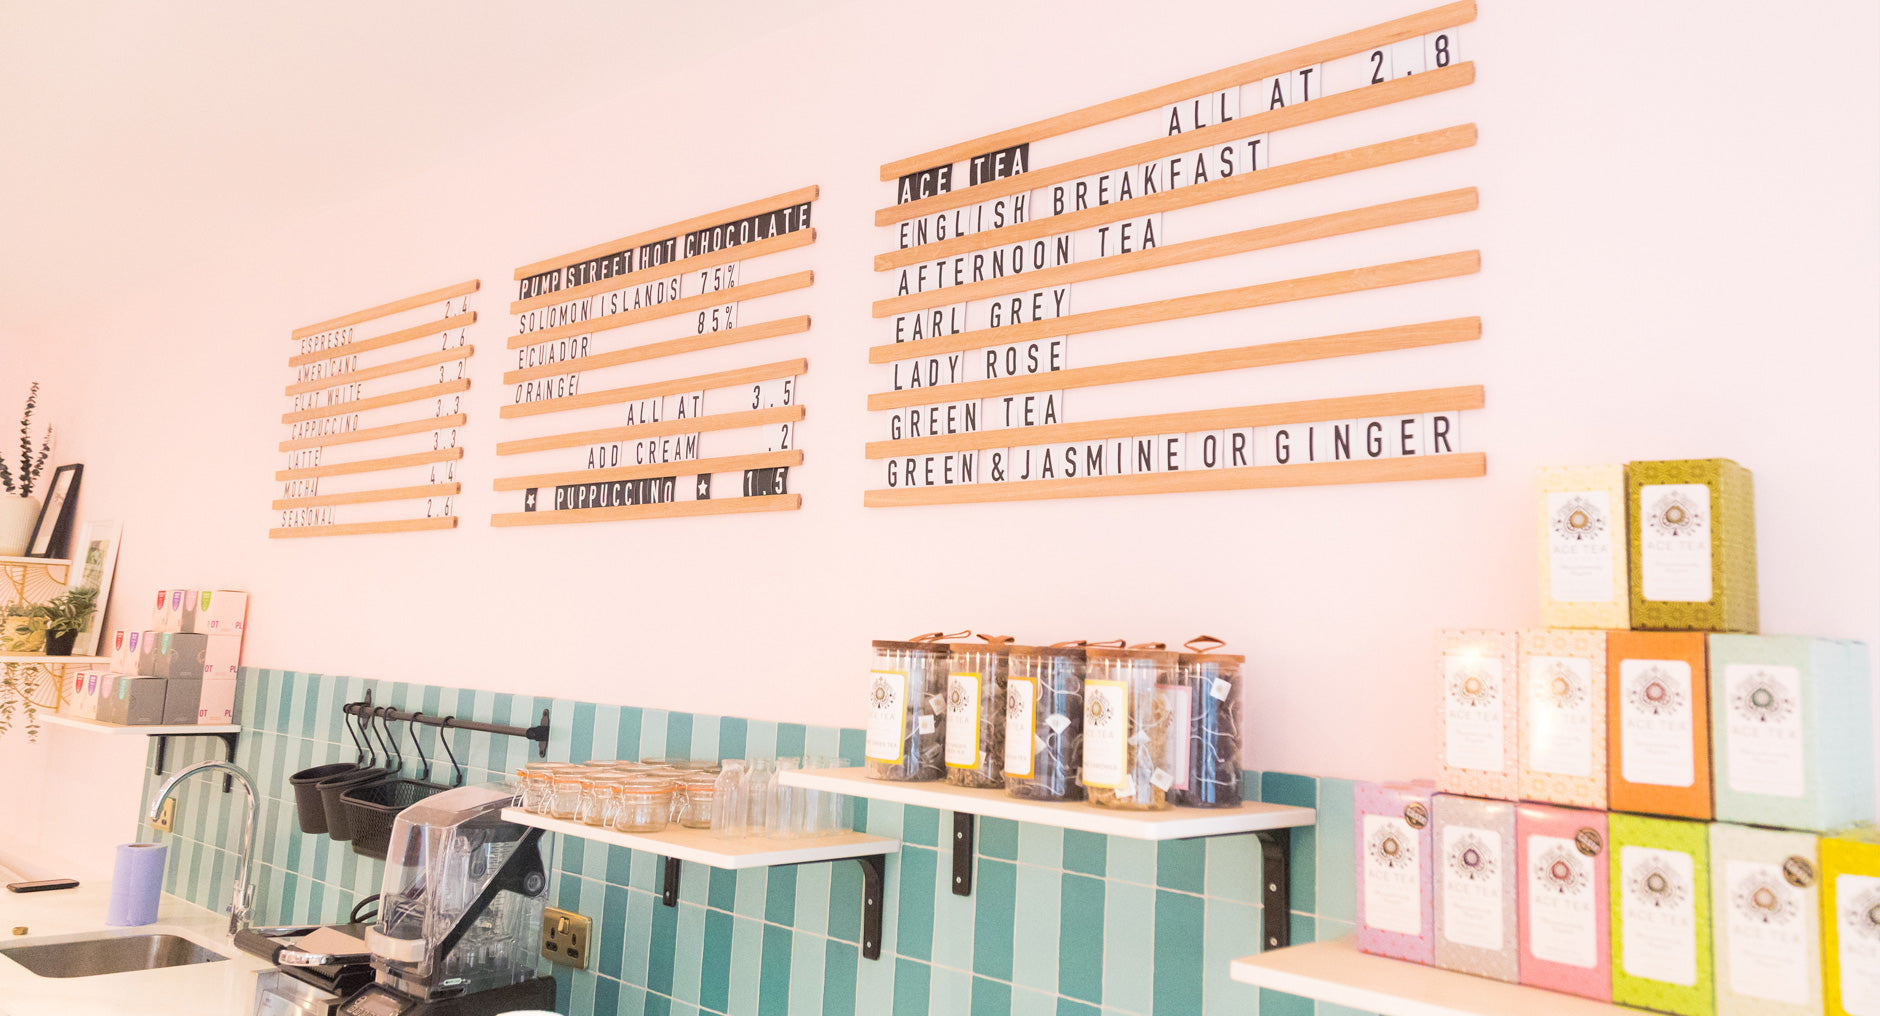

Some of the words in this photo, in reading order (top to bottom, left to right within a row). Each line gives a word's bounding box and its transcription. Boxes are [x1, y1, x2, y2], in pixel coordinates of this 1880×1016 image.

[1167, 92, 1233, 136] ALL
[1270, 68, 1314, 111] AT
[1369, 34, 1452, 84] 2.8
[901, 165, 949, 203] ACE
[974, 147, 1025, 184] TEA
[900, 194, 1026, 249] ENGLISH
[1053, 140, 1262, 216] BREAKFAST
[521, 273, 560, 300] PUMP
[567, 252, 633, 288] STREET
[641, 239, 675, 270] HOT
[686, 204, 808, 259] CHOCOLATE
[899, 235, 1069, 296] AFTERNOON
[1099, 218, 1157, 257] TEA
[444, 296, 467, 319] 2.4
[519, 299, 589, 334] SOLOMON
[600, 278, 678, 317] ISLANDS
[701, 264, 736, 295] 75%
[896, 307, 960, 343] EARL
[990, 289, 1066, 329] GREY
[301, 327, 354, 355] ESPRESSO
[442, 328, 465, 351] 2.6
[518, 336, 588, 370] ECUADOR
[698, 305, 733, 334] 85%
[297, 355, 357, 384] AMERICANO
[439, 361, 463, 384] 3.2
[893, 354, 960, 391] LADY
[986, 341, 1062, 379] ROSE
[294, 392, 320, 412] FLAT
[327, 383, 362, 406] WHITE
[515, 374, 576, 404] ORANGE
[627, 399, 659, 426] ALL
[678, 395, 700, 419] AT
[752, 380, 792, 410] 3.5
[436, 396, 460, 418] 3.3
[891, 402, 977, 440] GREEN
[1004, 394, 1057, 427] TEA
[292, 414, 359, 440] CAPPUCCINO
[433, 429, 456, 451] 3.3
[288, 449, 319, 471] LATTE
[588, 444, 619, 469] ADD
[636, 435, 696, 465] CREAM
[887, 451, 974, 488] GREEN
[990, 453, 1006, 482] &
[1021, 438, 1179, 480] JASMINE
[1203, 431, 1248, 468] OR
[1275, 415, 1453, 464] GINGER
[283, 480, 315, 498] MOCHA
[557, 479, 673, 510] PUPPUCCINO
[746, 468, 785, 497] 1.5
[281, 506, 332, 527] SEASONAL
